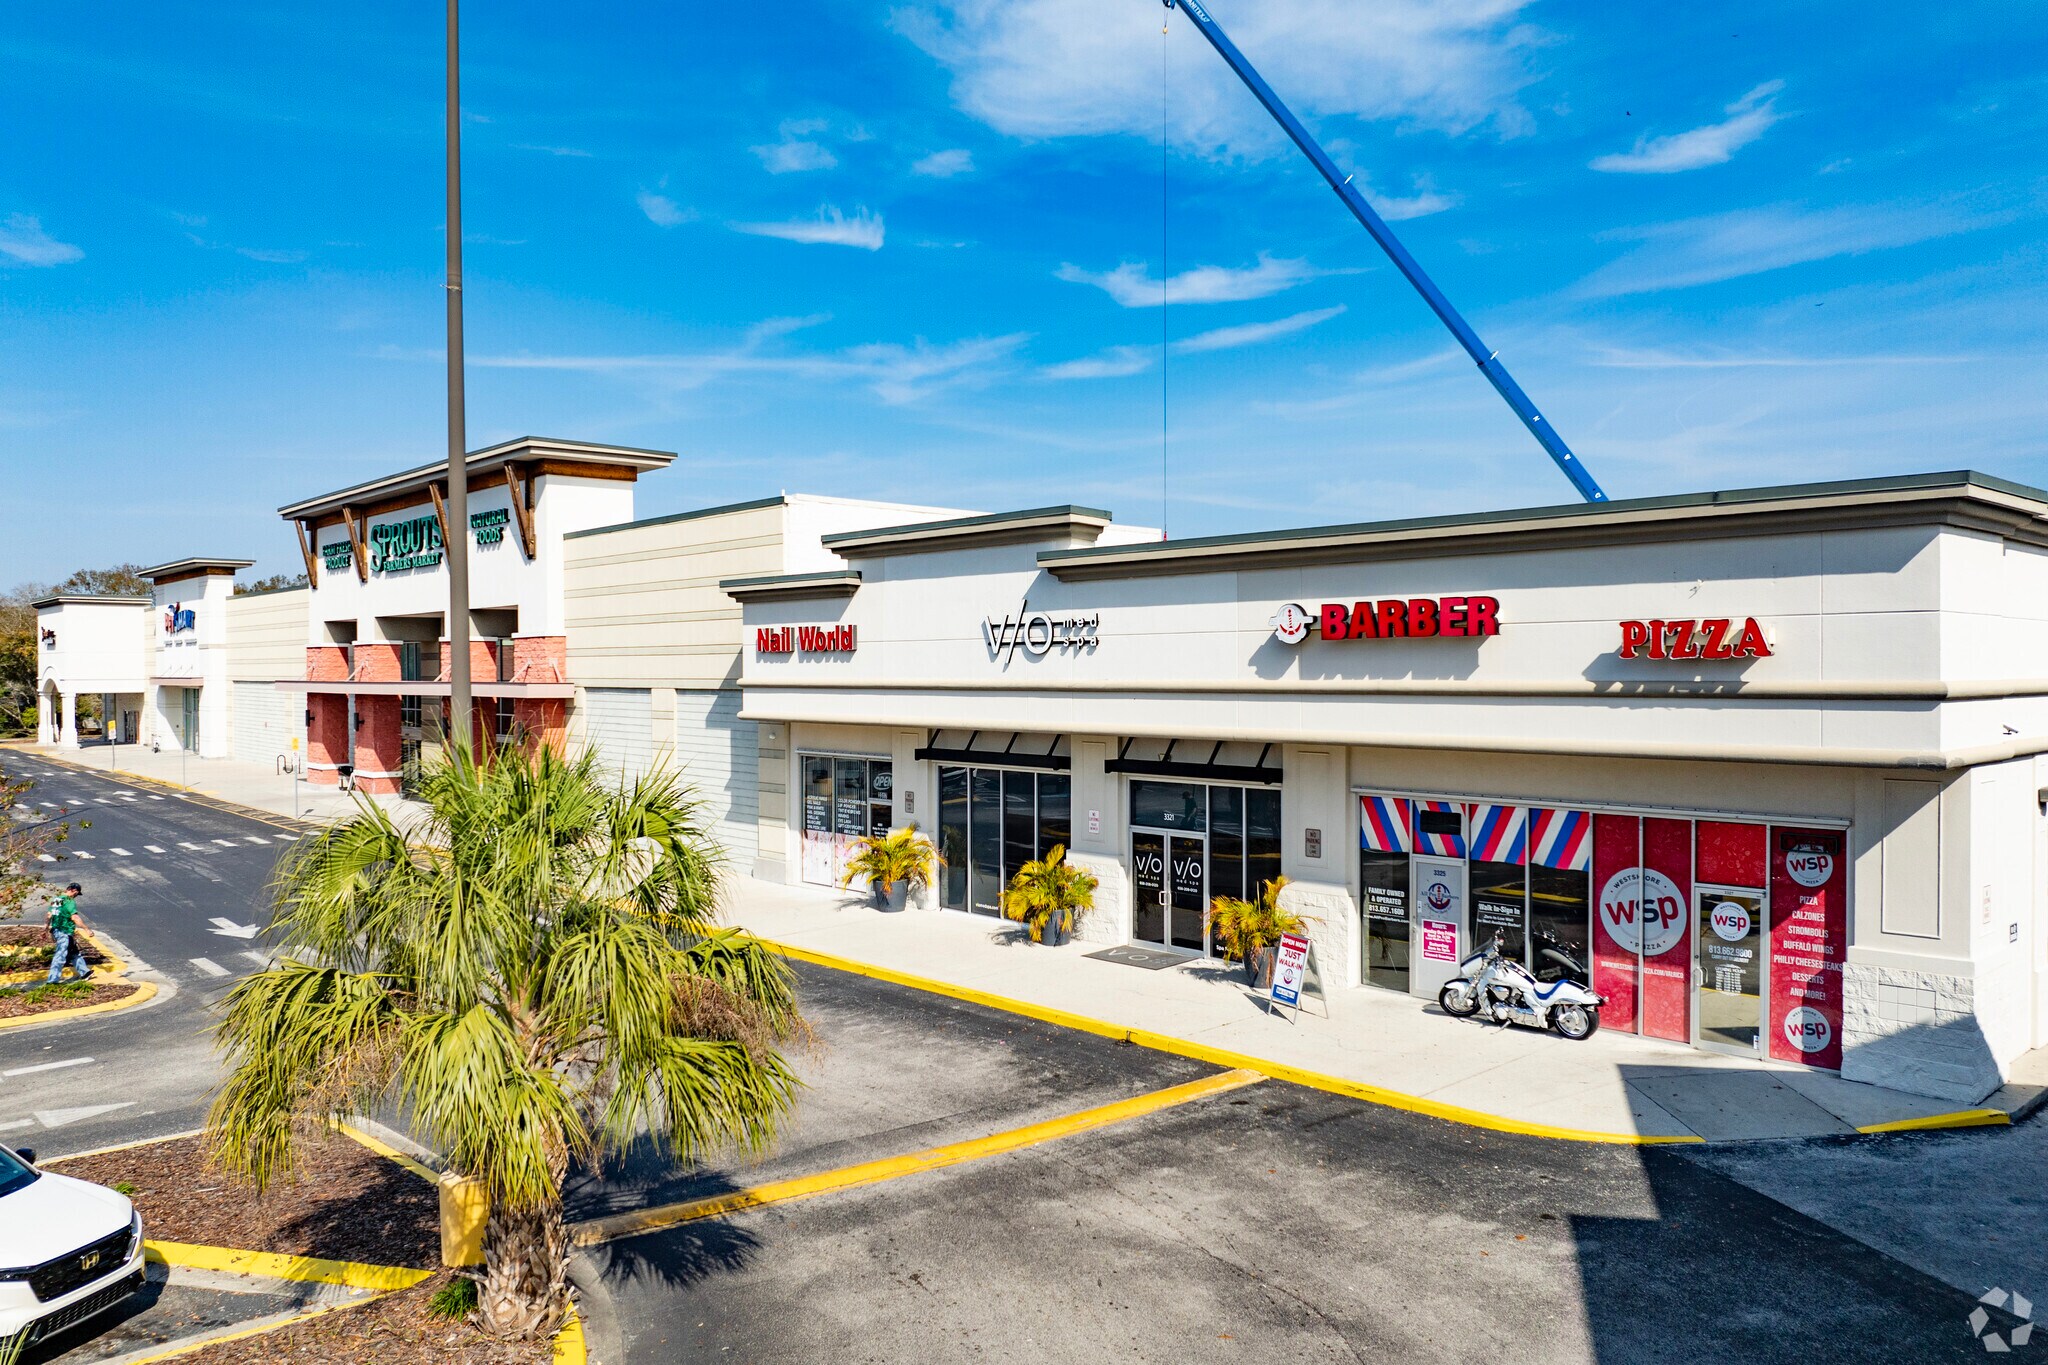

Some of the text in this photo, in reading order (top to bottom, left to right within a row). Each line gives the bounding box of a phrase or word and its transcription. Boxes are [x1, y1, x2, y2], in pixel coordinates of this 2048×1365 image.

[1184, 0, 1207, 22] ANITEX
[470, 508, 508, 528] NATURAL
[475, 527, 502, 544] FOODS
[370, 515, 443, 572] SPROUTS
[384, 552, 442, 571] FARMERS MARKET
[1062, 613, 1098, 628] med
[1321, 596, 1500, 640] BARBER
[757, 624, 856, 652] Nail World
[1062, 636, 1099, 649] spa
[1619, 617, 1774, 660] PIZZA
[874, 776, 892, 787] OPEN
[1613, 874, 1661, 889] WESTSORE
[1368, 887, 1405, 898] FAMILY OWNED
[1376, 896, 1402, 906] OPERATED
[1478, 903, 1493, 911] Walk
[1799, 896, 1818, 905] PIZZA
[1792, 910, 1825, 922] CALZONES
[1787, 925, 1829, 939] STROMBOLIS
[1282, 937, 1307, 949] OPEN NOW
[1783, 940, 1834, 955] BUFFALO WINGS
[1284, 949, 1302, 960] JUST
[1279, 958, 1303, 971] WALK-IN
[1773, 954, 1843, 972] PHILLY CHEESESTEAKS
[1792, 972, 1824, 985] DESSERTS
[1789, 987, 1826, 1000] AND MORE!
